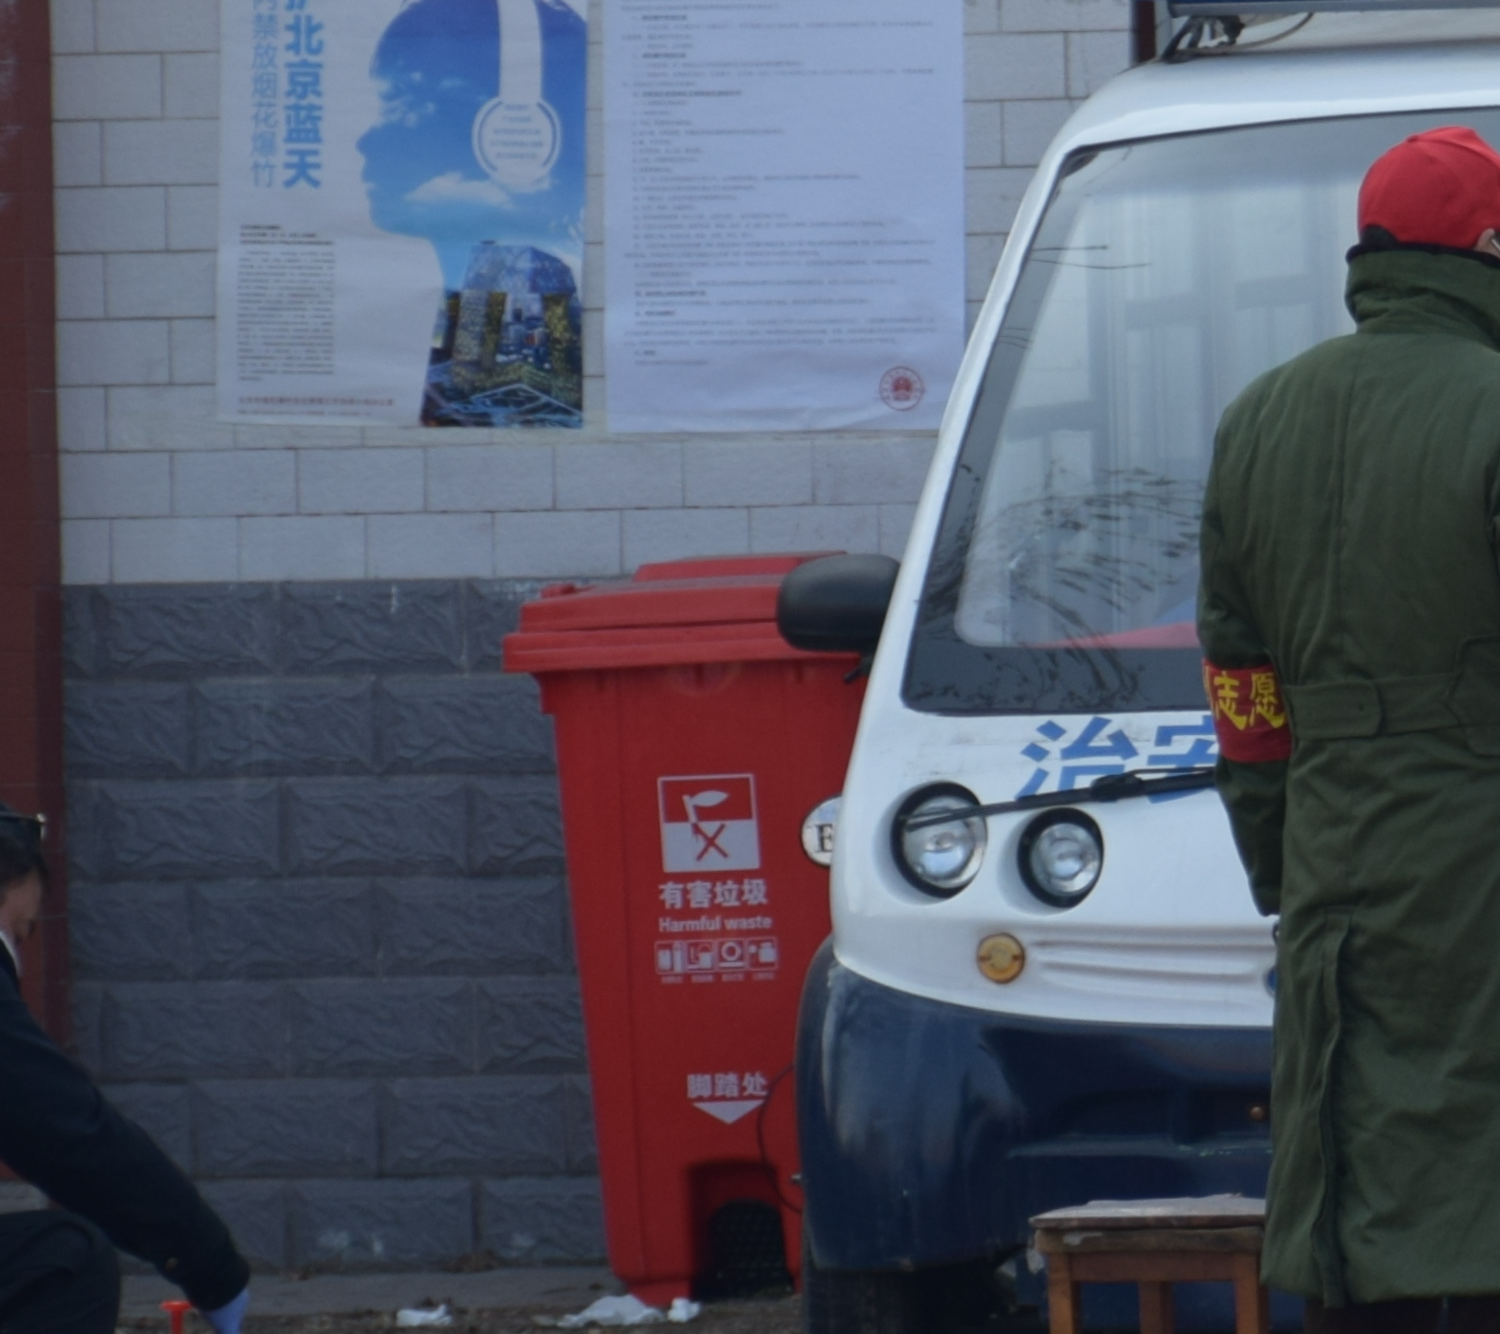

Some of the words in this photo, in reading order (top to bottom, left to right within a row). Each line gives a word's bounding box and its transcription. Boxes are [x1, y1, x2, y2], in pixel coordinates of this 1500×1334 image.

[658, 878, 768, 909] 有害垃圾
[659, 916, 721, 932] Harmful
[724, 916, 772, 930] waste
[687, 1071, 768, 1099] 脚踏处
